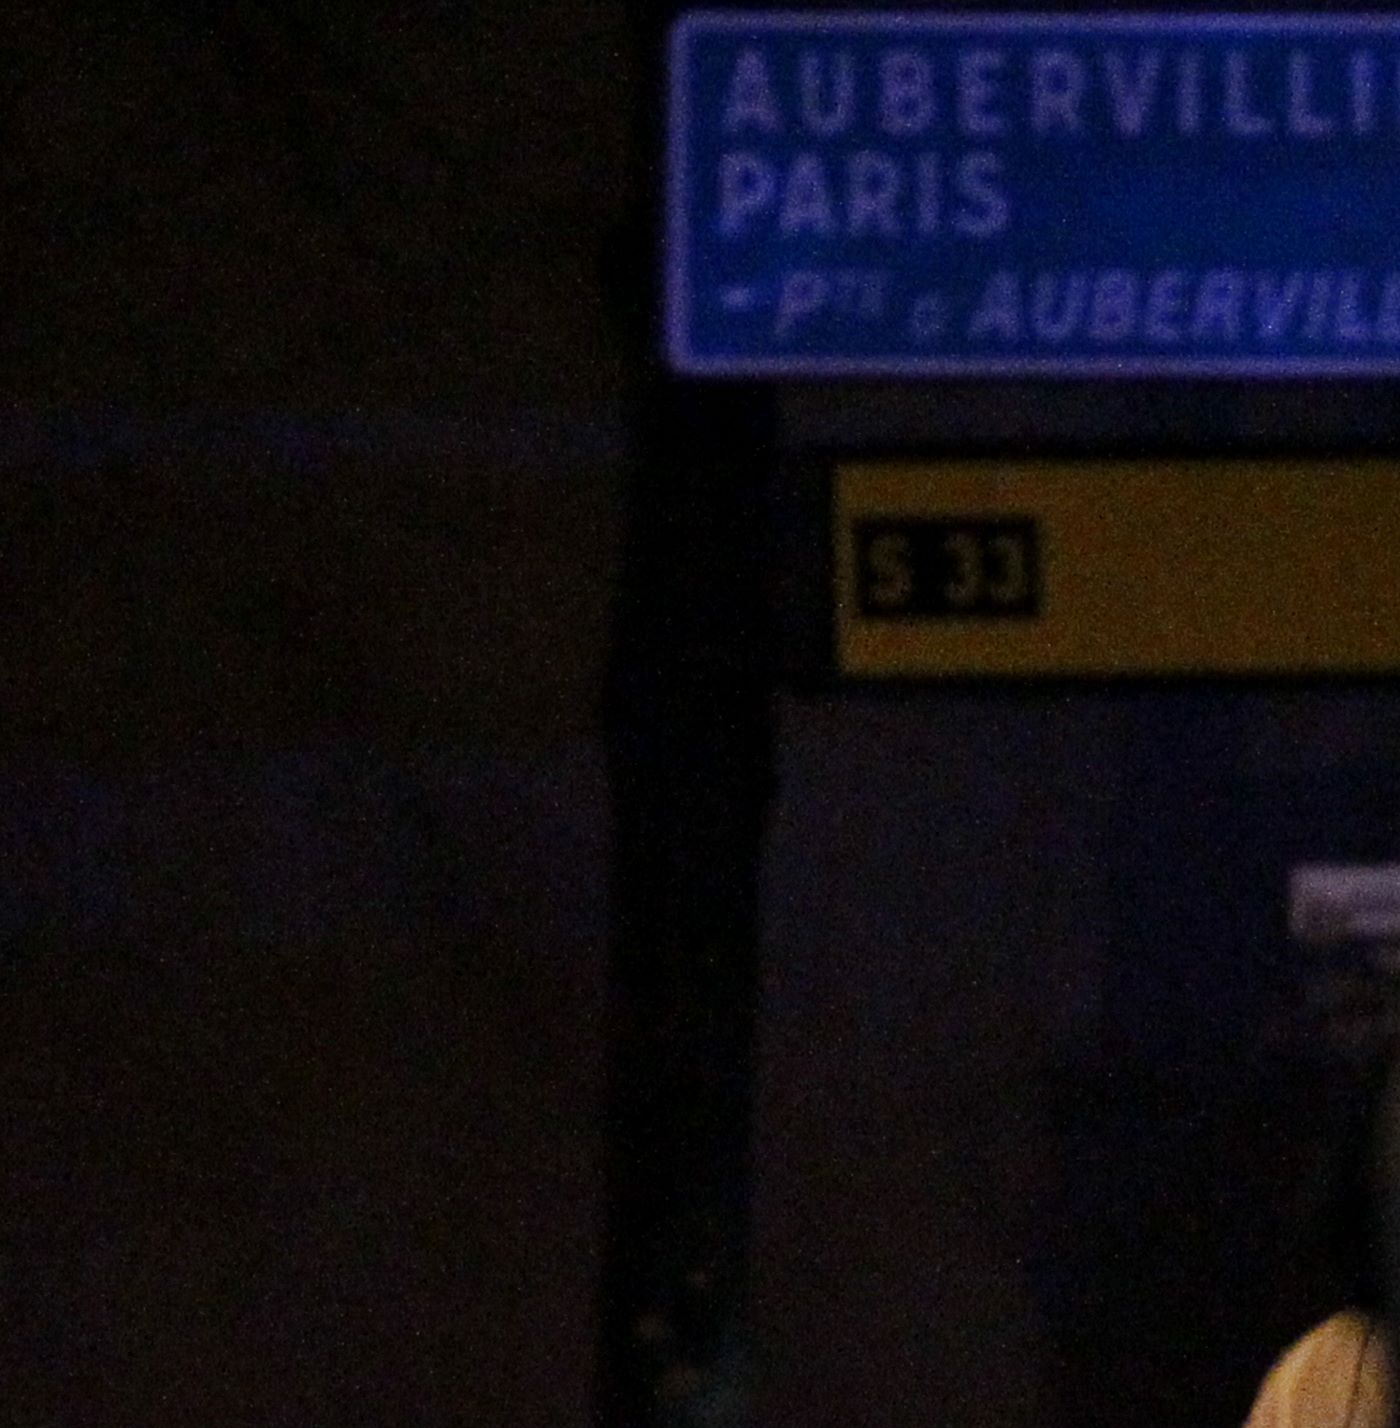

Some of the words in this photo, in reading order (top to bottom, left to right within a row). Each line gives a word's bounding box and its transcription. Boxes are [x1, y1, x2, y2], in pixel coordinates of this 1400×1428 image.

[717, 150, 1010, 239] PARIS
[868, 533, 913, 605] S
[943, 533, 1024, 605] 33
